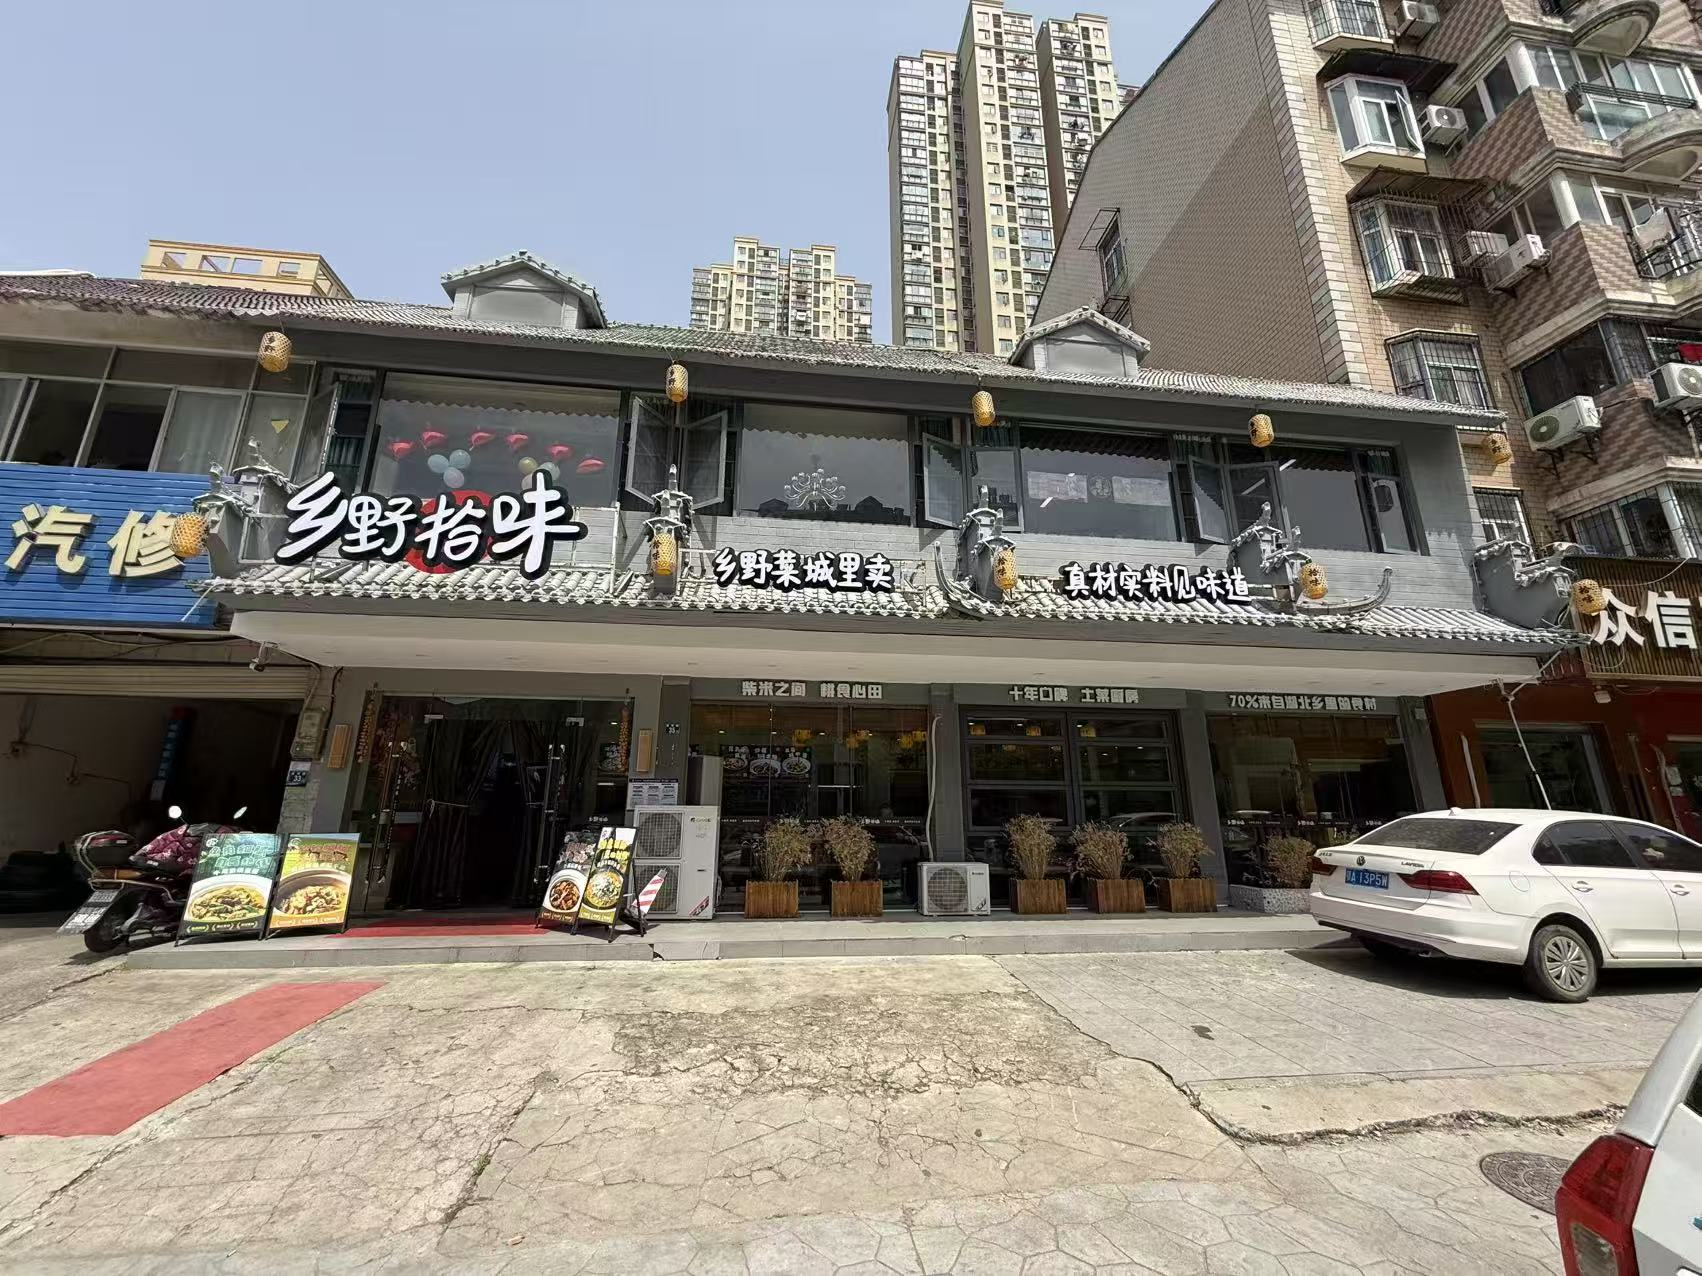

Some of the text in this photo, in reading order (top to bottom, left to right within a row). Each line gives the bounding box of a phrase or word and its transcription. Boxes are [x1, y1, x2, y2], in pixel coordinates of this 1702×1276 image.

[5, 504, 186, 578] 汽修
[277, 471, 582, 576] 乡野拾味
[713, 547, 895, 592] 乡野菜城里卖
[1064, 562, 1250, 602] 真材实料见味道
[1591, 588, 1698, 650] 众信
[742, 681, 806, 697] 柴米之间
[1009, 686, 1069, 702] 十年口碑
